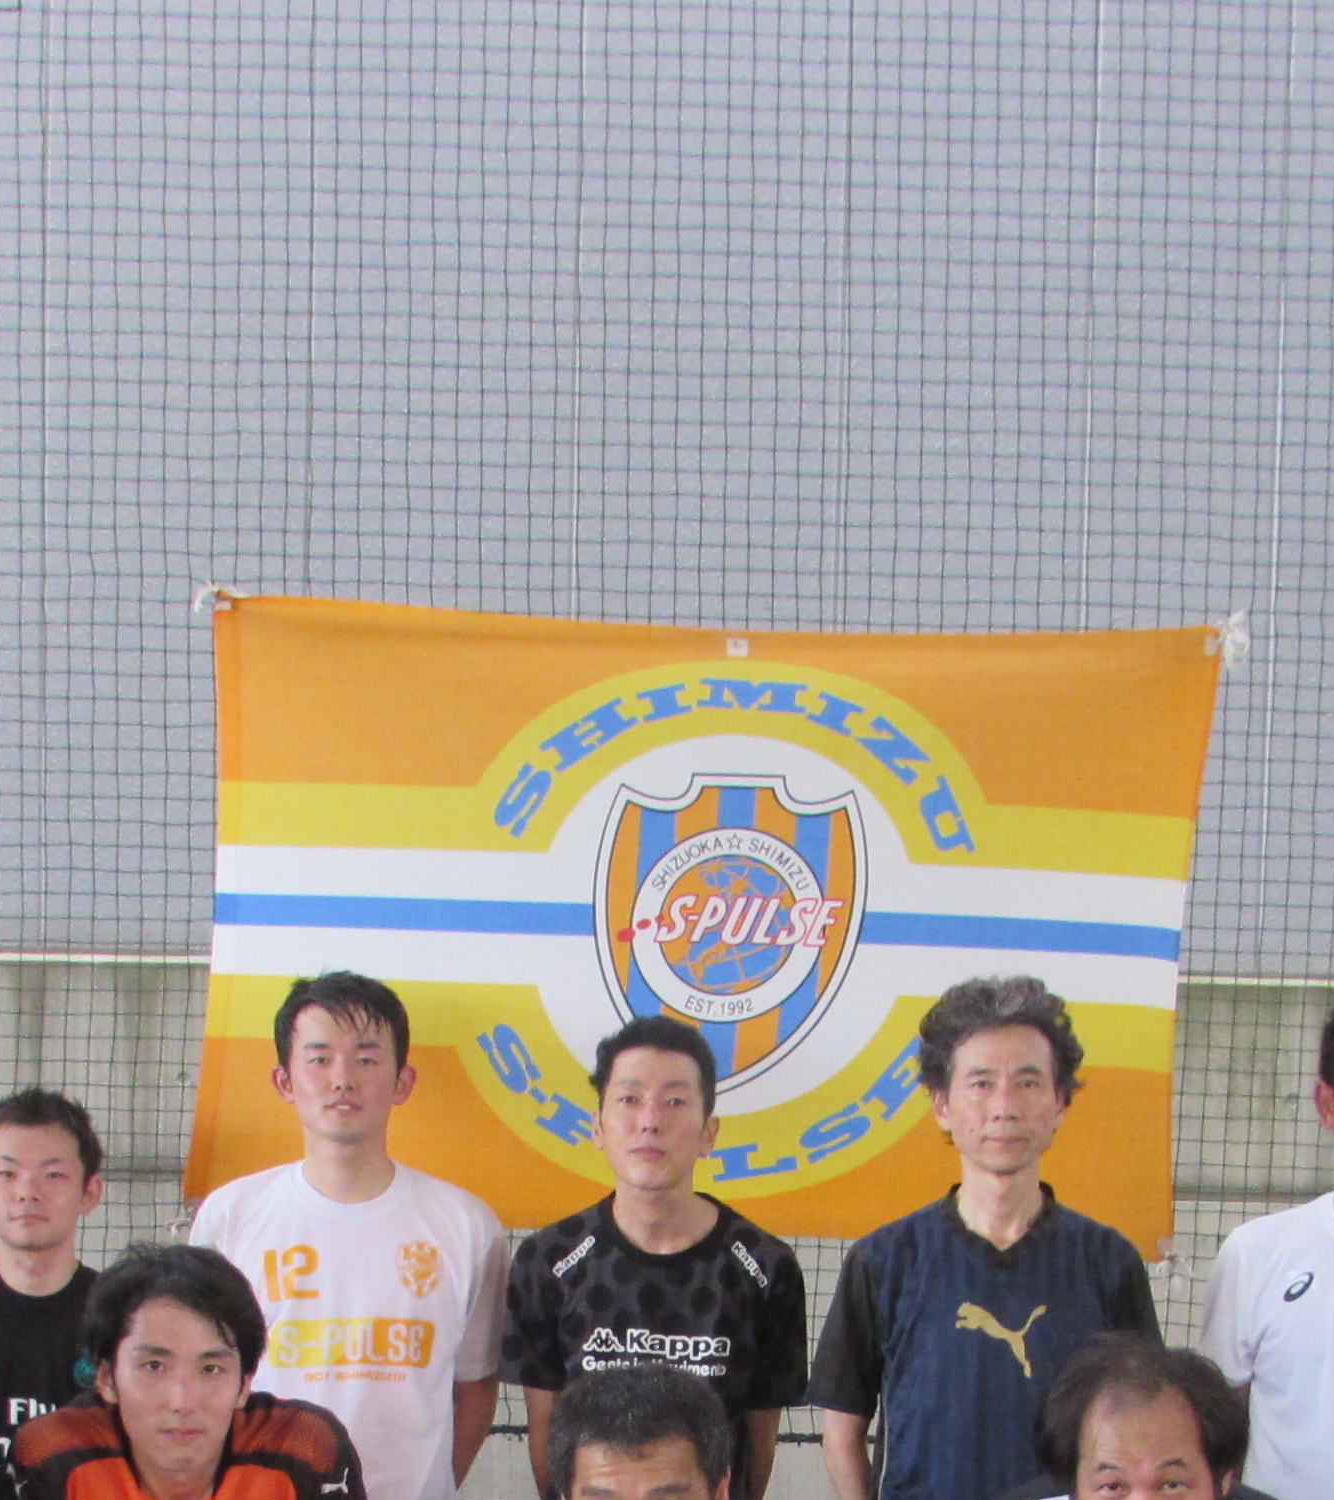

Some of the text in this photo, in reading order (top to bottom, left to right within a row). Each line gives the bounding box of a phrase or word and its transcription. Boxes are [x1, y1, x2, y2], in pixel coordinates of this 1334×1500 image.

[493, 678, 975, 854] SHIMIZU
[651, 836, 811, 892] SHIZUOKA SHIMIZU
[653, 893, 846, 947] S-PULSE
[263, 1244, 320, 1304] 12
[553, 1235, 596, 1278] Kappa
[731, 1241, 767, 1288] Kappa
[278, 1321, 425, 1365] S-PULSE
[626, 1328, 731, 1361] Kappa
